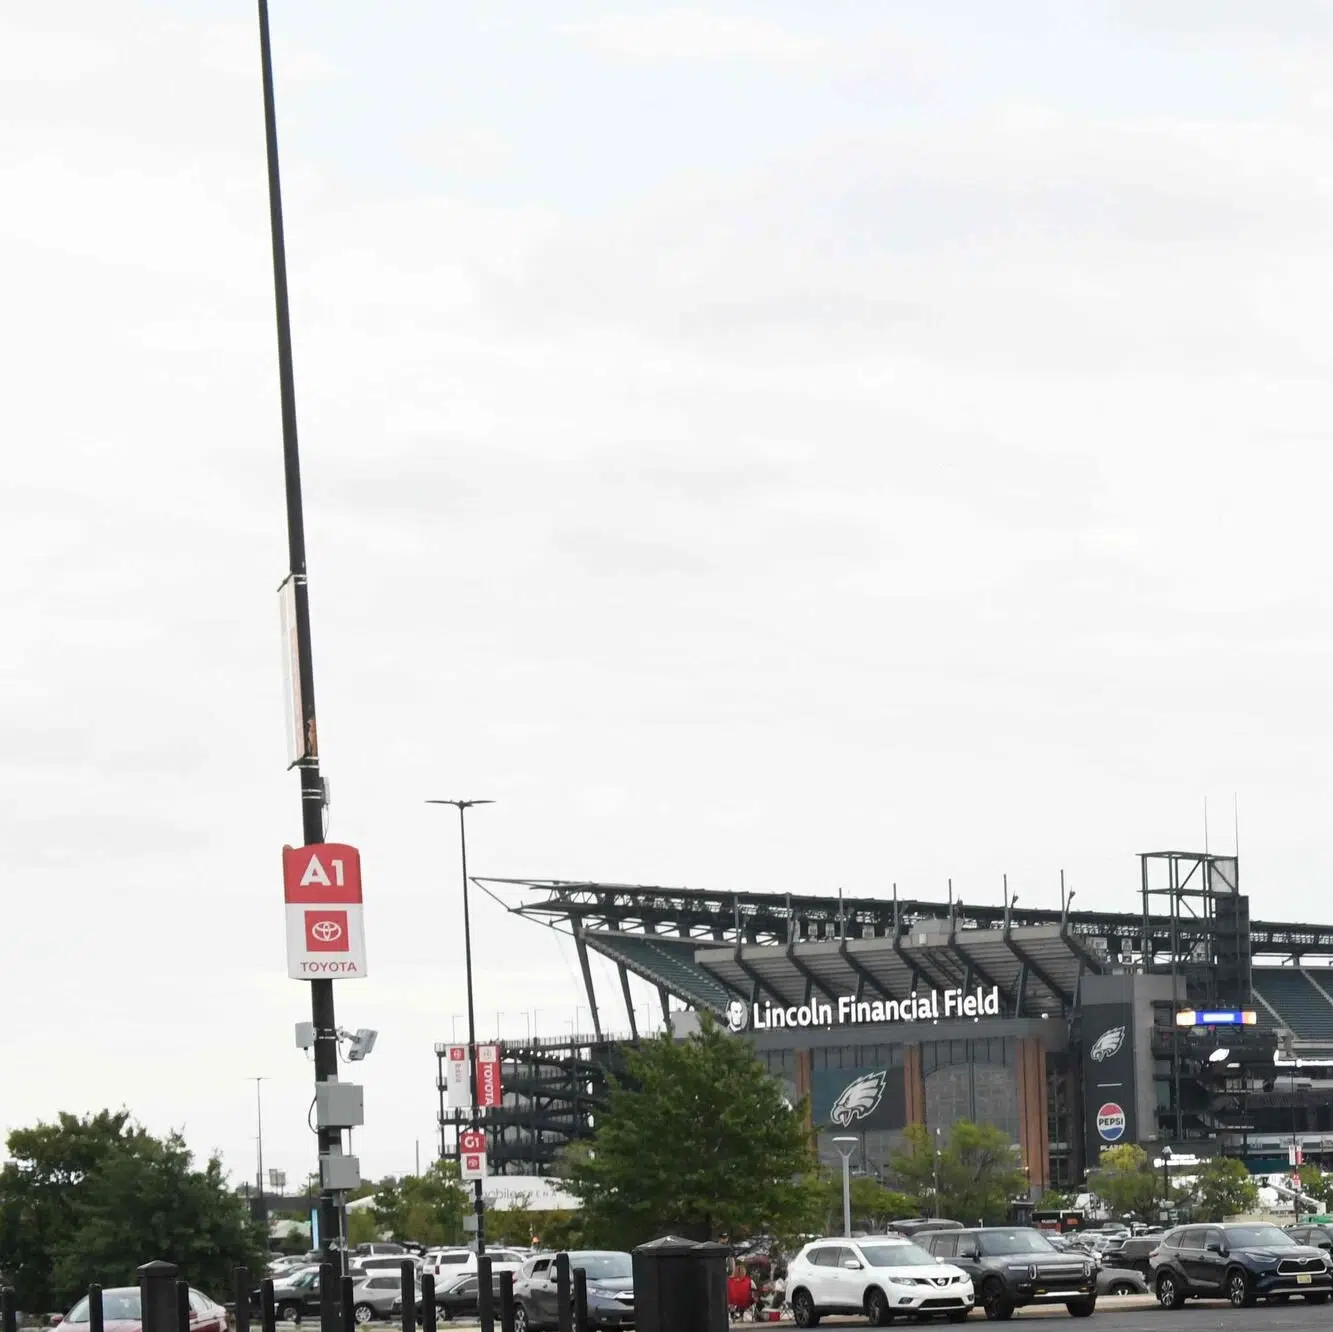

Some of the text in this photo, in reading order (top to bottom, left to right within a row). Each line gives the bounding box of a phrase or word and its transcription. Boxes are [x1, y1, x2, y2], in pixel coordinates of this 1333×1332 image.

[299, 853, 345, 887] A1
[299, 961, 358, 973] TOYOTA
[753, 984, 1000, 1029] Lincoln Financial Field
[483, 1063, 495, 1106] TOYOTA
[1098, 1117, 1125, 1127] PEPSI
